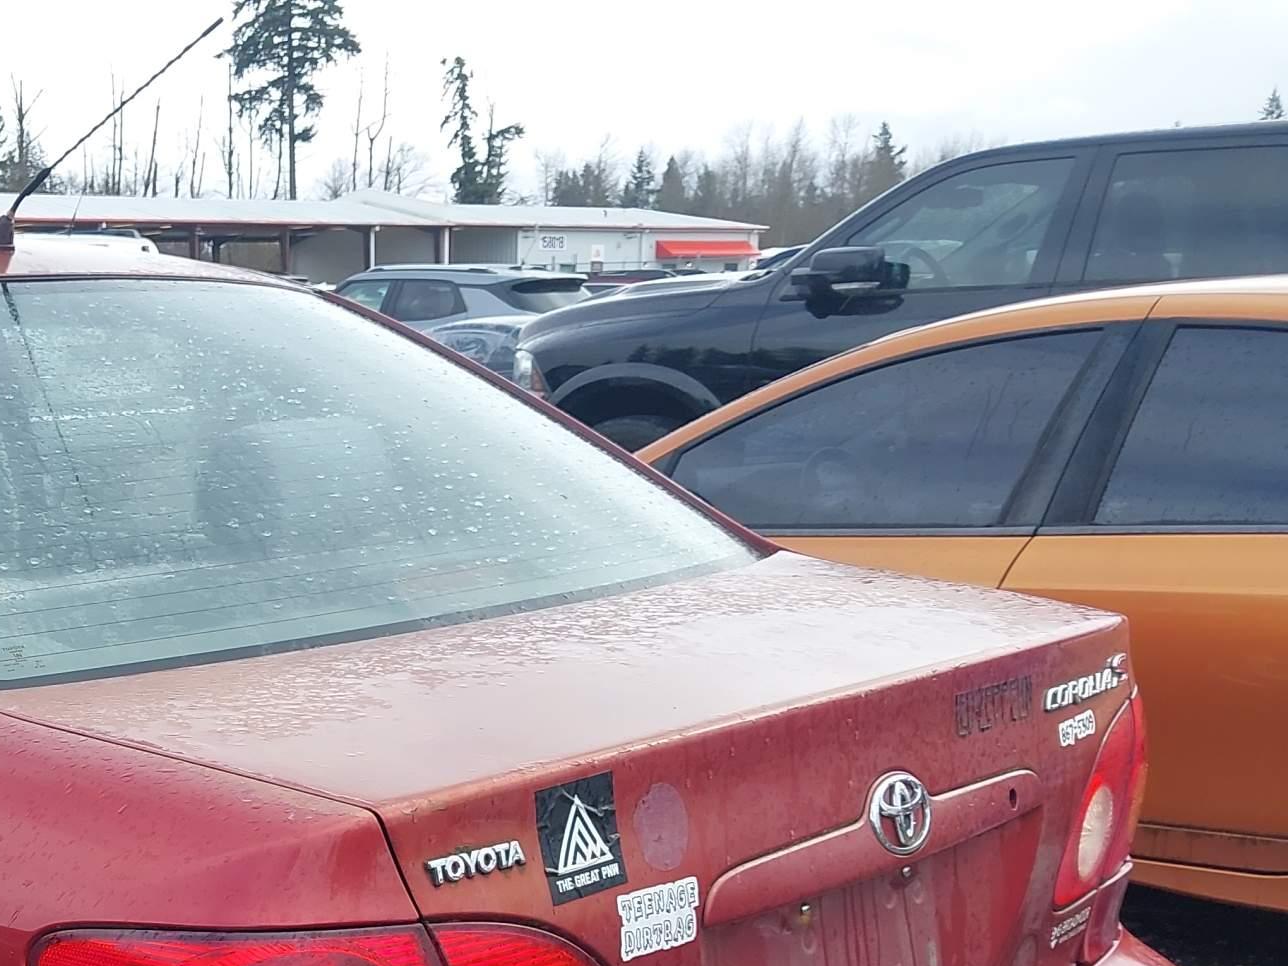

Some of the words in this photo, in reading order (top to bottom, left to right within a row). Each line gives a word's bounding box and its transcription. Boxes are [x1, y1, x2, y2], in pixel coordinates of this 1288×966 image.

[427, 840, 526, 885] TOYOTA
[556, 877, 574, 893] THE
[574, 870, 602, 888] GREAT
[601, 862, 620, 880] PNW
[621, 881, 697, 923] TEENAGE
[624, 914, 695, 956] DIRTBAG
